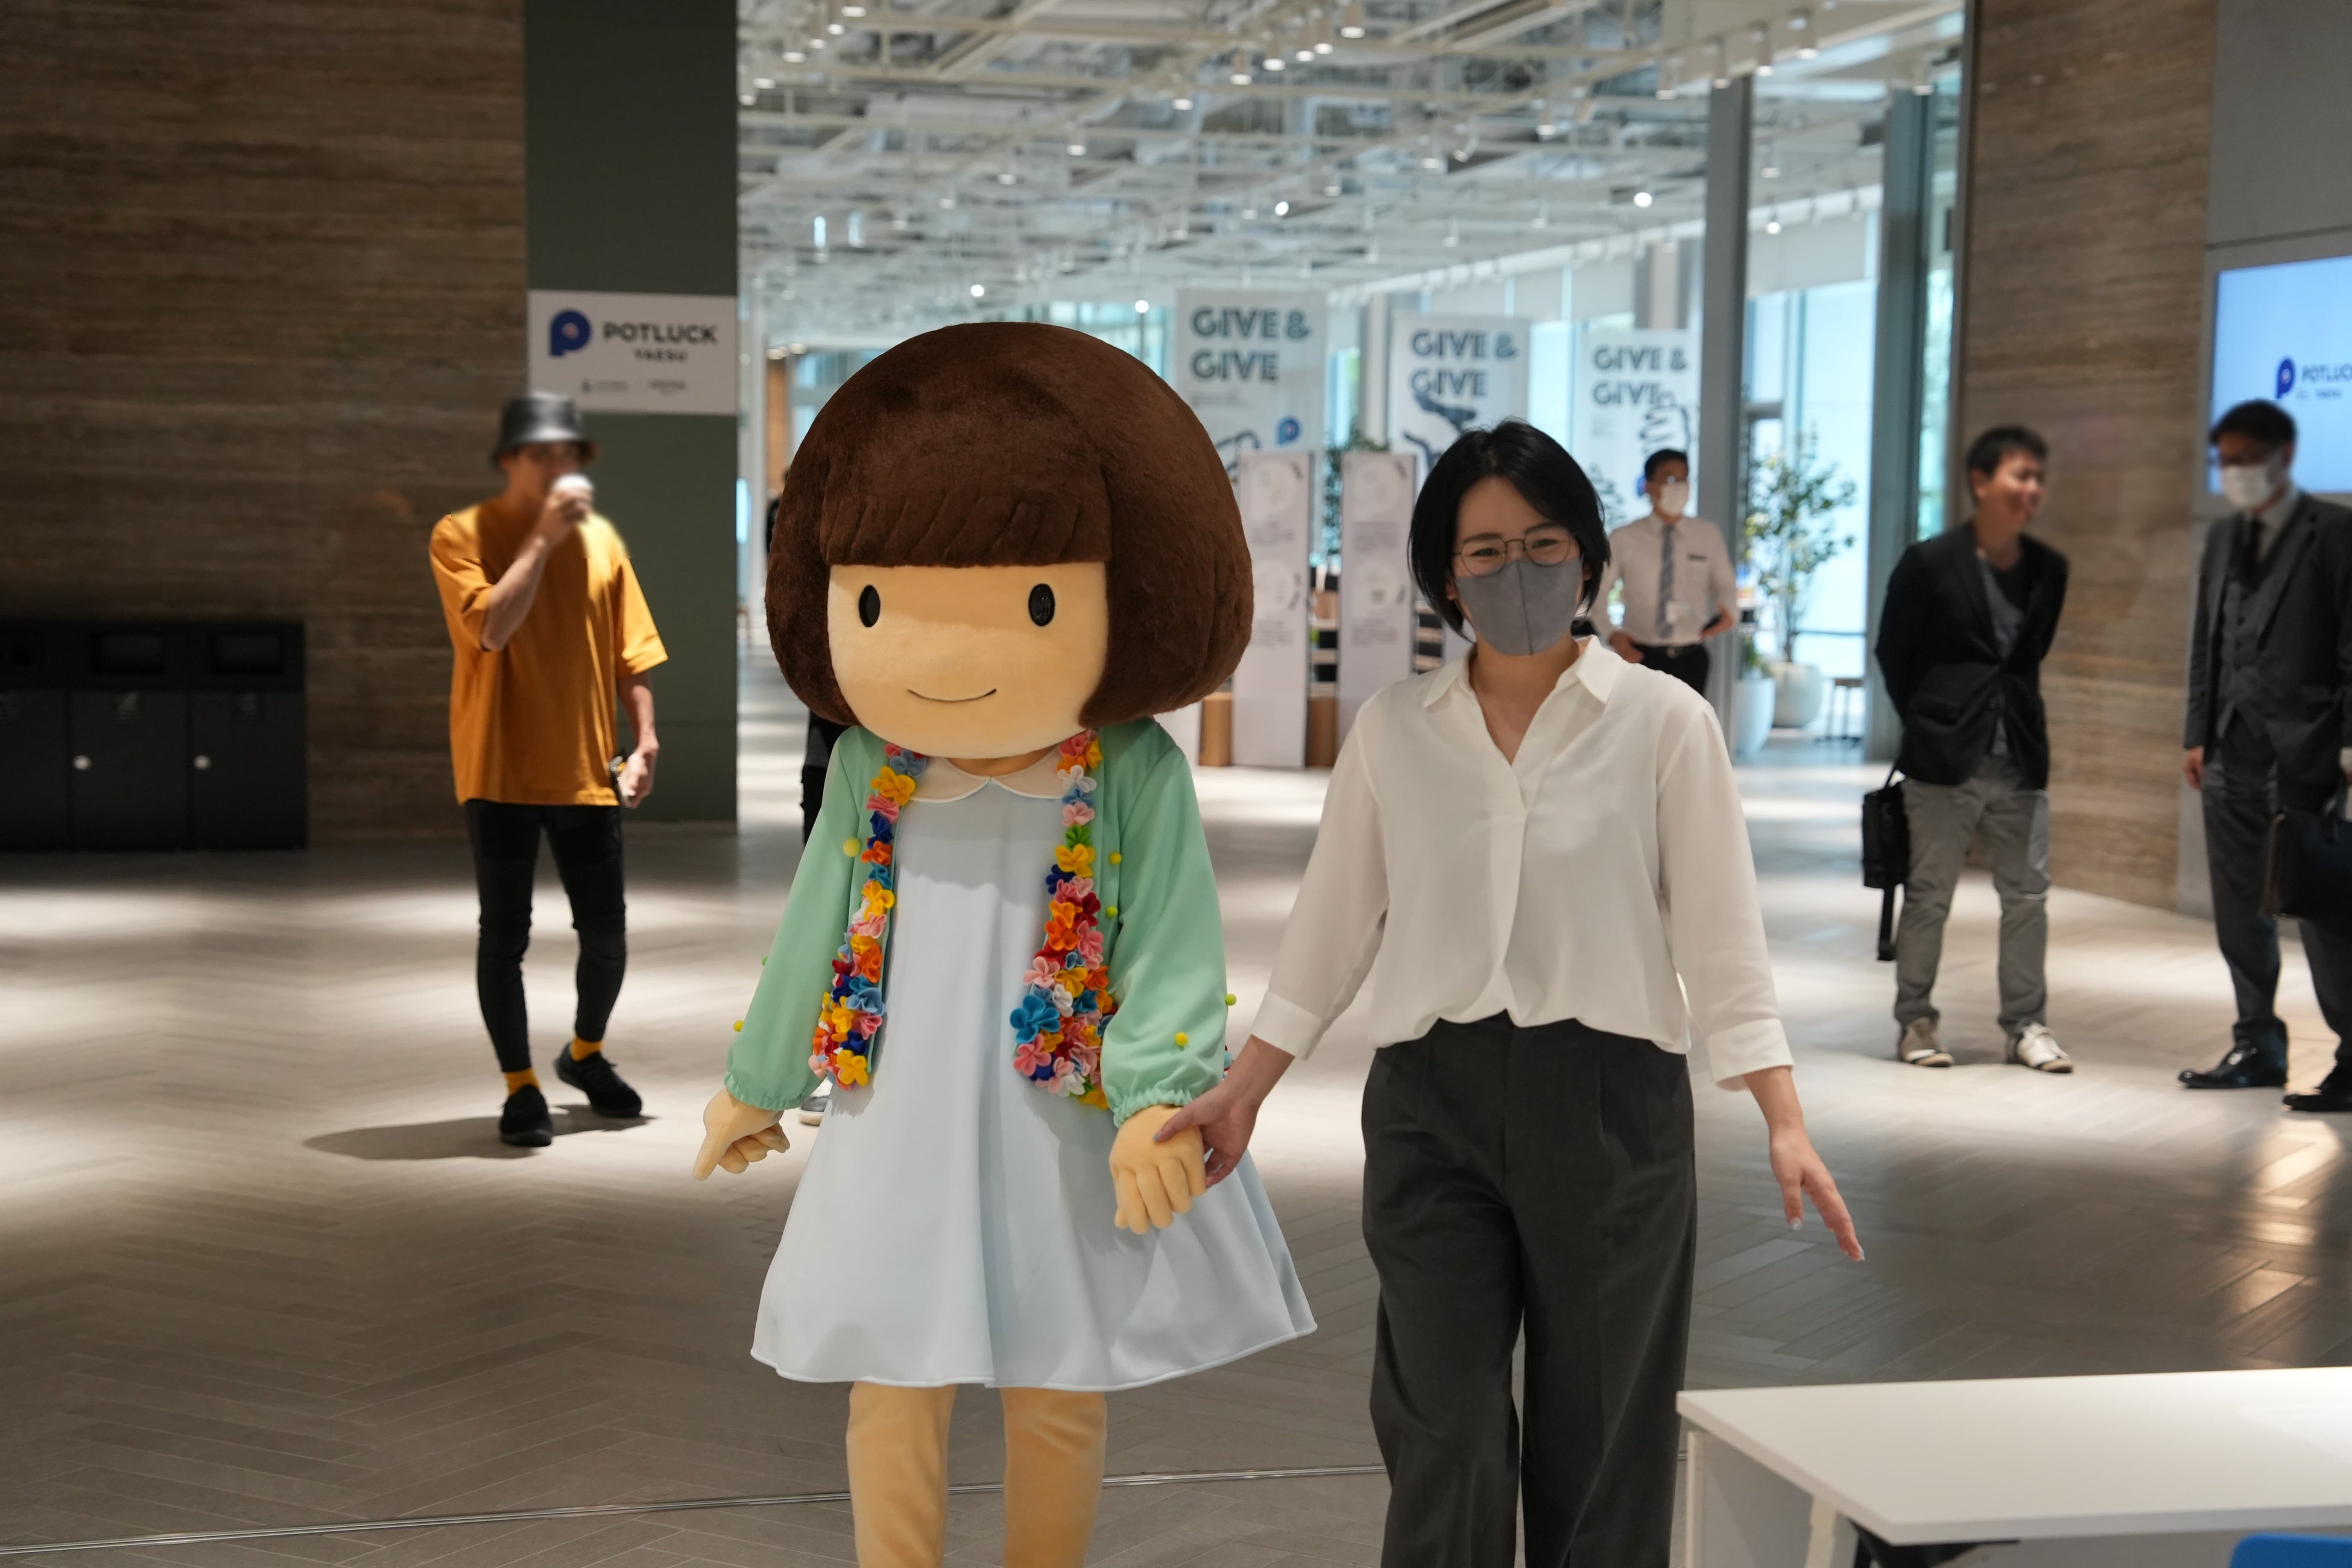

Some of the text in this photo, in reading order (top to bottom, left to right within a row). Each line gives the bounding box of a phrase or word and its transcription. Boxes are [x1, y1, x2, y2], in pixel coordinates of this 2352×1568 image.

[603, 321, 718, 344] POTLUCK
[1190, 306, 1311, 340] GIVE &
[1411, 329, 1517, 358] GIVE &
[1190, 349, 1279, 383] GIVE
[1593, 344, 1687, 372] GIVE &
[1411, 369, 1488, 396] GIVE
[2302, 363, 2352, 382] POTLUC
[1593, 381, 1660, 406] GIVE
